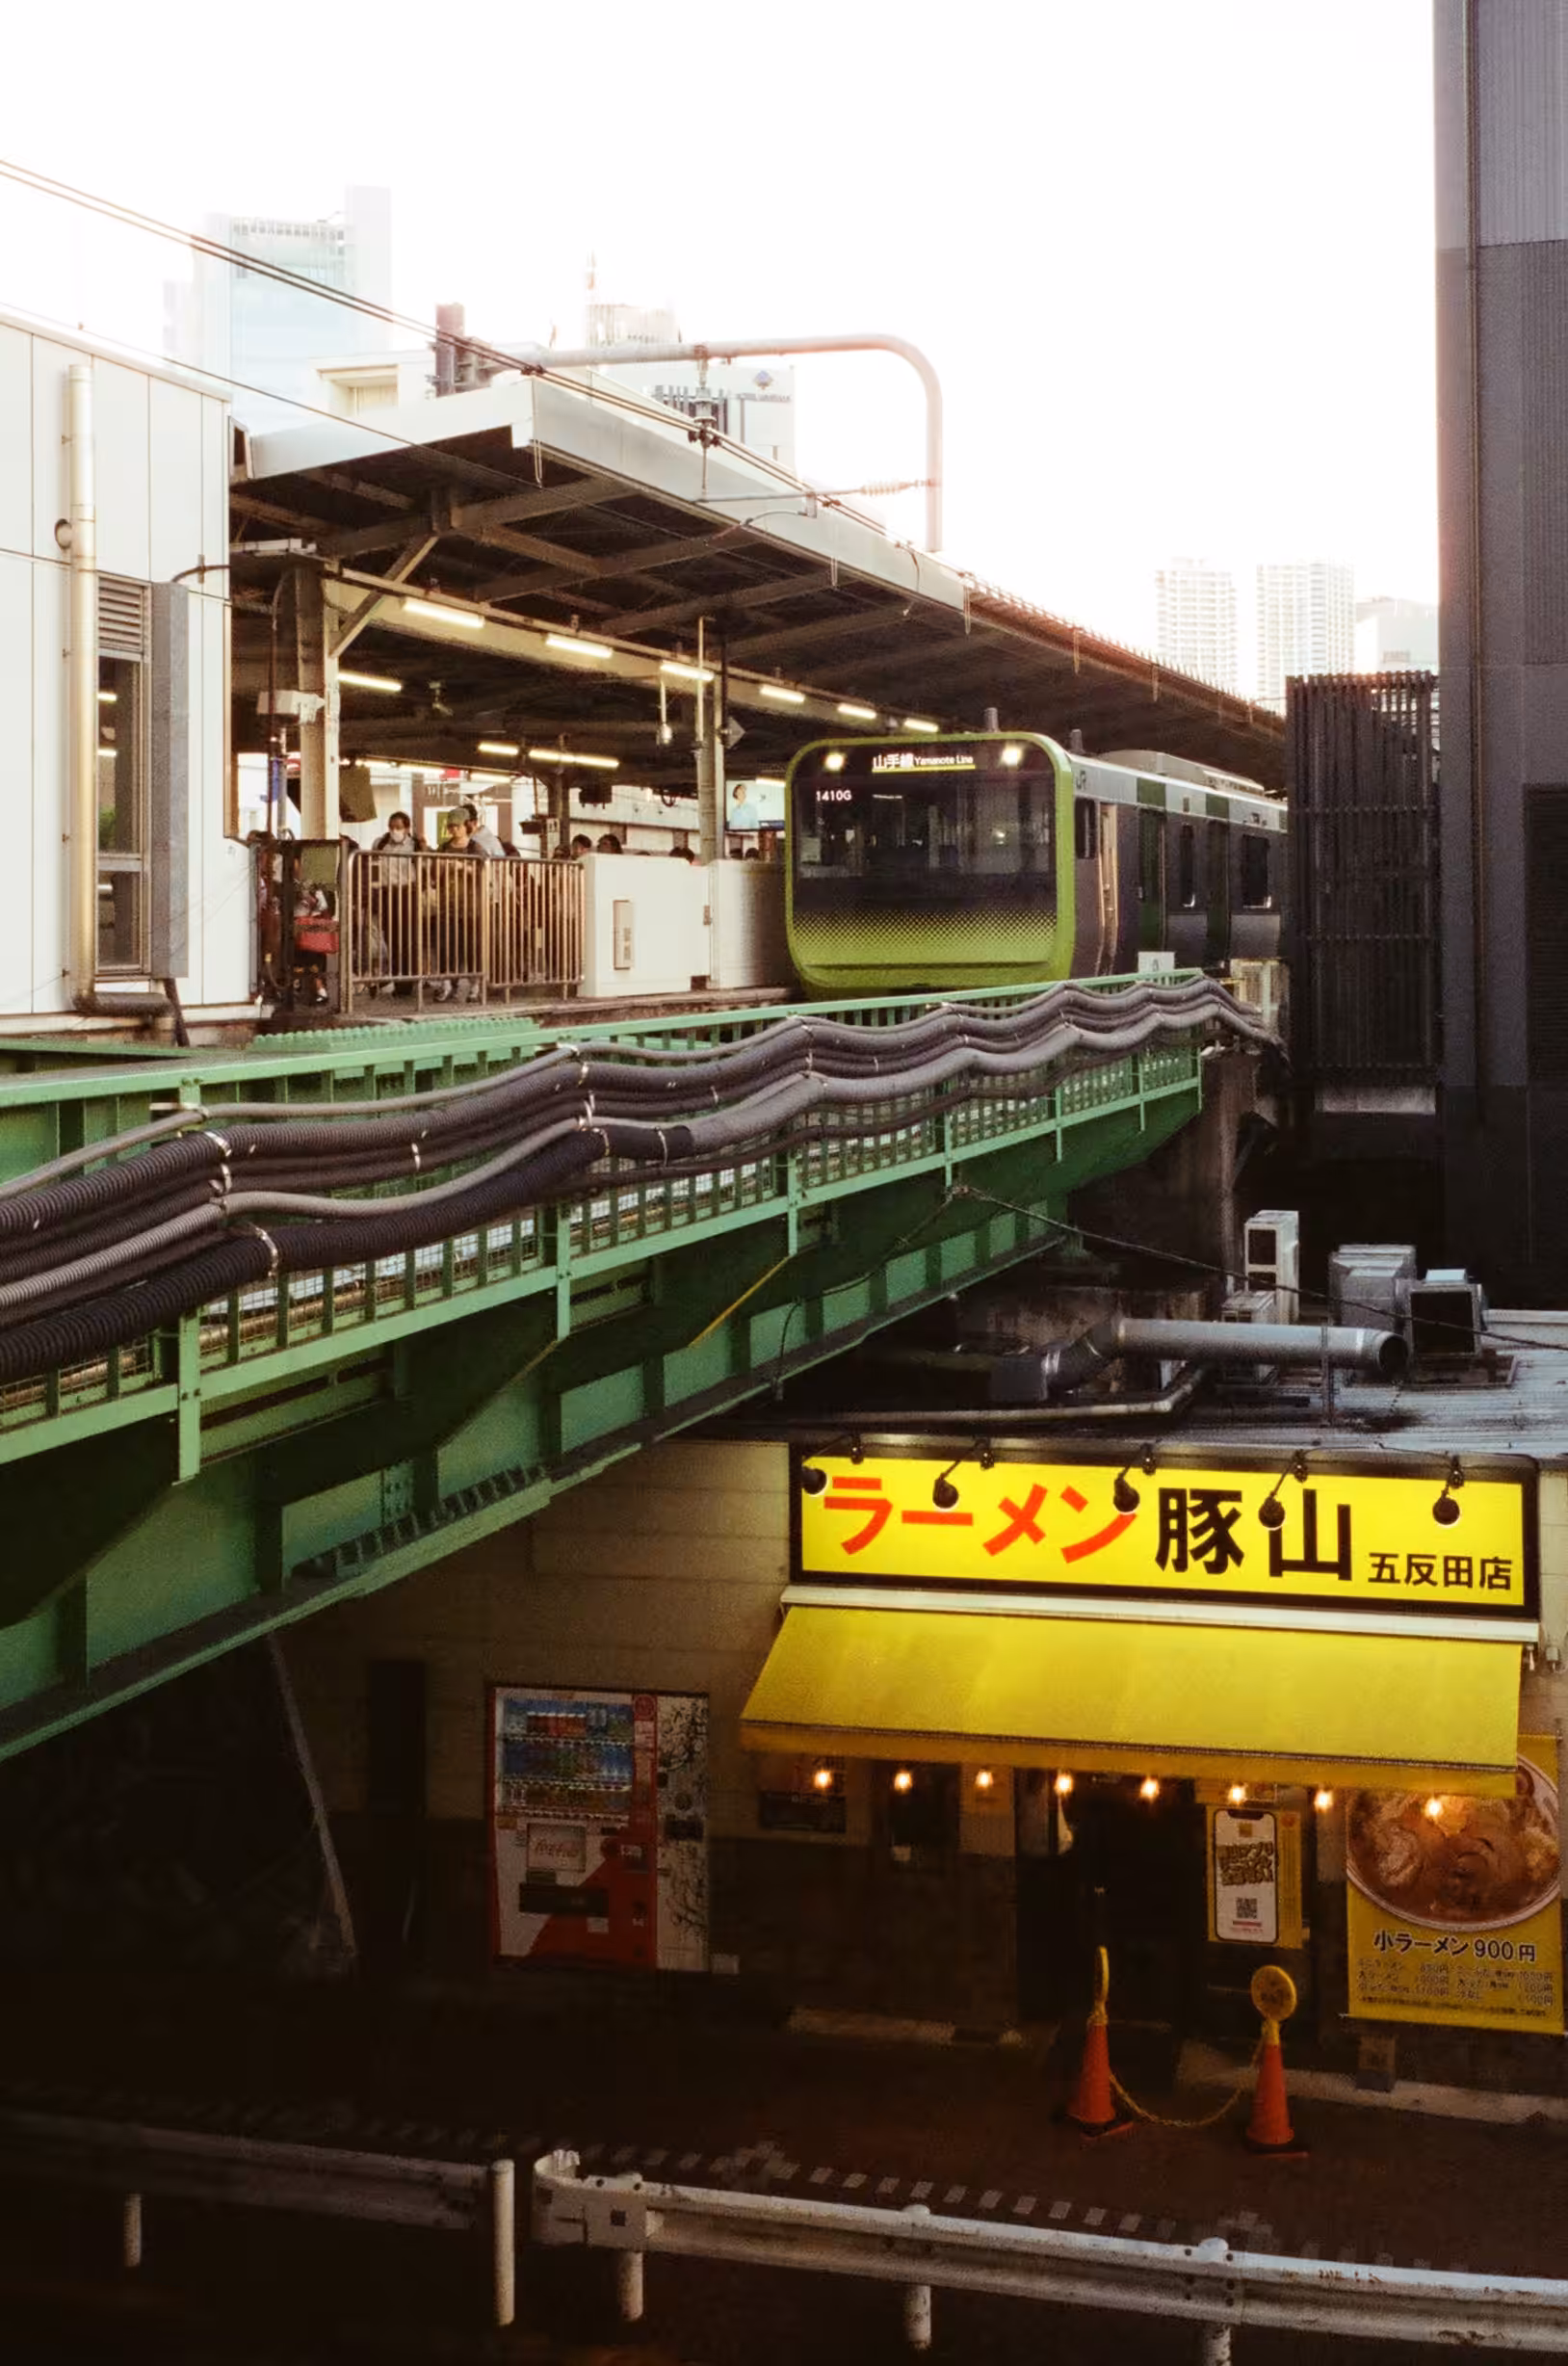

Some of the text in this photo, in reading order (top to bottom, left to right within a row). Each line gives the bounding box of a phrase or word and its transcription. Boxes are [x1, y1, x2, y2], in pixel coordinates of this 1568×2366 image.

[915, 756, 954, 766] Yamanote
[956, 754, 974, 764] Line
[816, 790, 852, 802] 1410G
[1367, 1552, 1513, 1590] 五反田店
